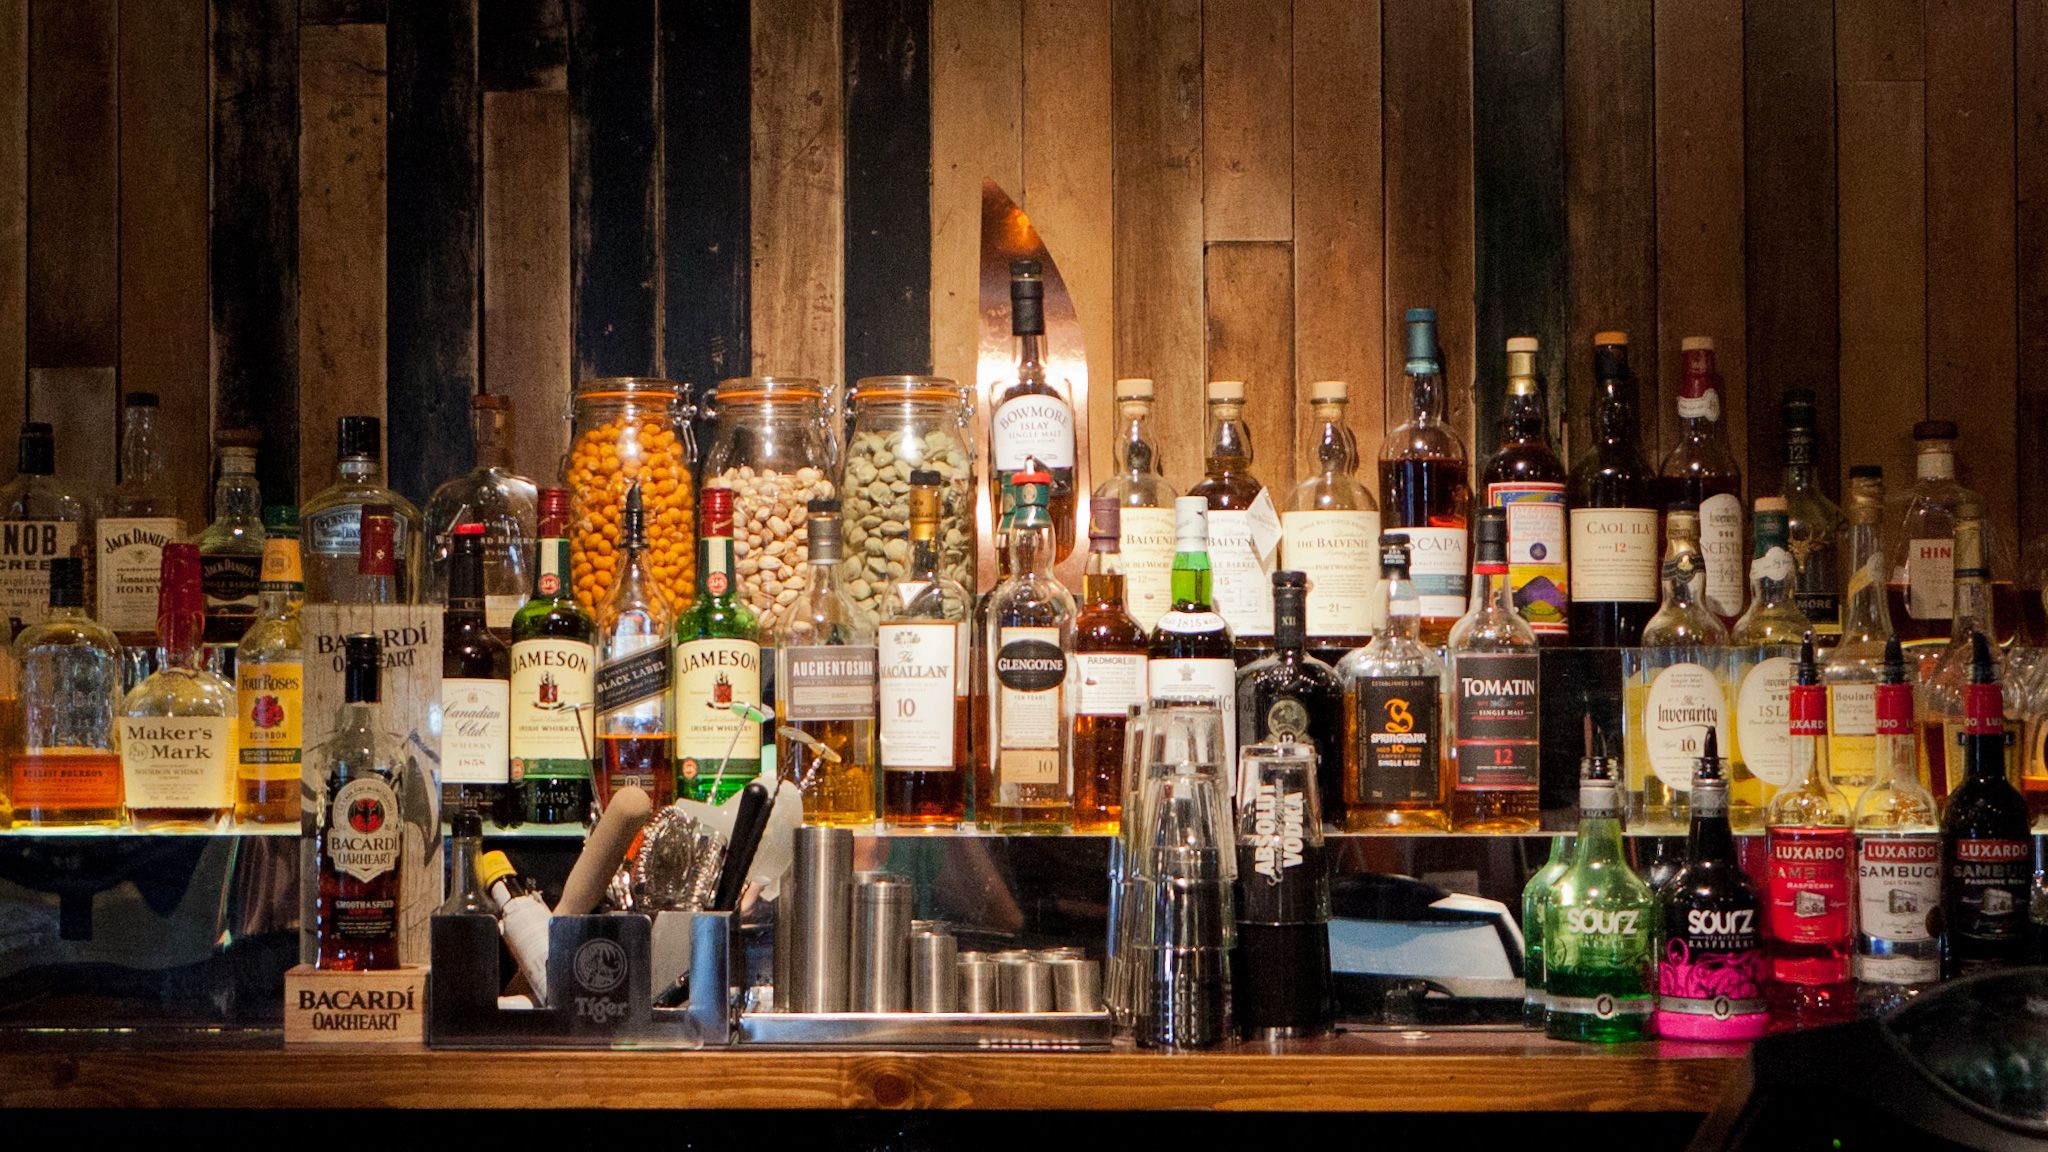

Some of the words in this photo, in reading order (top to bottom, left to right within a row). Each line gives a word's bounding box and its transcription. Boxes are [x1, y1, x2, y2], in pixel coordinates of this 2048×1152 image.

[1000, 406, 1069, 430] BOWMORE
[1587, 521, 1627, 534] CAOL
[1632, 522, 1650, 534] ILA
[4, 524, 57, 556] NOB
[105, 531, 132, 554] JACK
[133, 528, 170, 547] DANIE
[1297, 540, 1312, 549] THE
[1317, 537, 1369, 548] BALVENIE
[1614, 543, 1627, 553] 12
[1920, 547, 1952, 559] HIN
[0, 560, 50, 570] CREE
[1328, 603, 1340, 613] 21
[318, 621, 428, 654] BARDÍ
[333, 650, 416, 672] OEART
[513, 650, 589, 674] JAMESON
[682, 650, 758, 674] JAMESON
[998, 658, 1063, 671] GLENGOYNE
[242, 674, 265, 690] Four
[264, 675, 299, 690] Roses
[597, 673, 631, 693] BLACK
[632, 661, 666, 679] LABEL
[1462, 677, 1535, 697] TOMATIN
[443, 701, 501, 719] Canadian
[896, 698, 916, 717] 10
[1658, 703, 1717, 726] Inverarity
[455, 719, 489, 737] Club
[1790, 719, 1826, 729] UXARD
[128, 726, 213, 741] Maker's
[1370, 733, 1428, 744] SPRINGBANK
[151, 744, 211, 759] Mark
[1392, 744, 1406, 754] 10
[1681, 738, 1696, 752] 10
[1494, 748, 1513, 766] 12
[1037, 759, 1052, 773] 10
[1776, 846, 1844, 860] LUXARDO
[1868, 845, 1936, 859] LUXARDO
[1961, 844, 2028, 857] LUXARDO
[338, 853, 393, 865] OAKHEART
[1786, 881, 1834, 889] RASPBERRY
[1689, 940, 1754, 949] RASPBERRY
[299, 986, 415, 1010] BACARDÍ
[574, 996, 628, 1023] Tiger
[312, 1011, 401, 1031] OAKHEART
